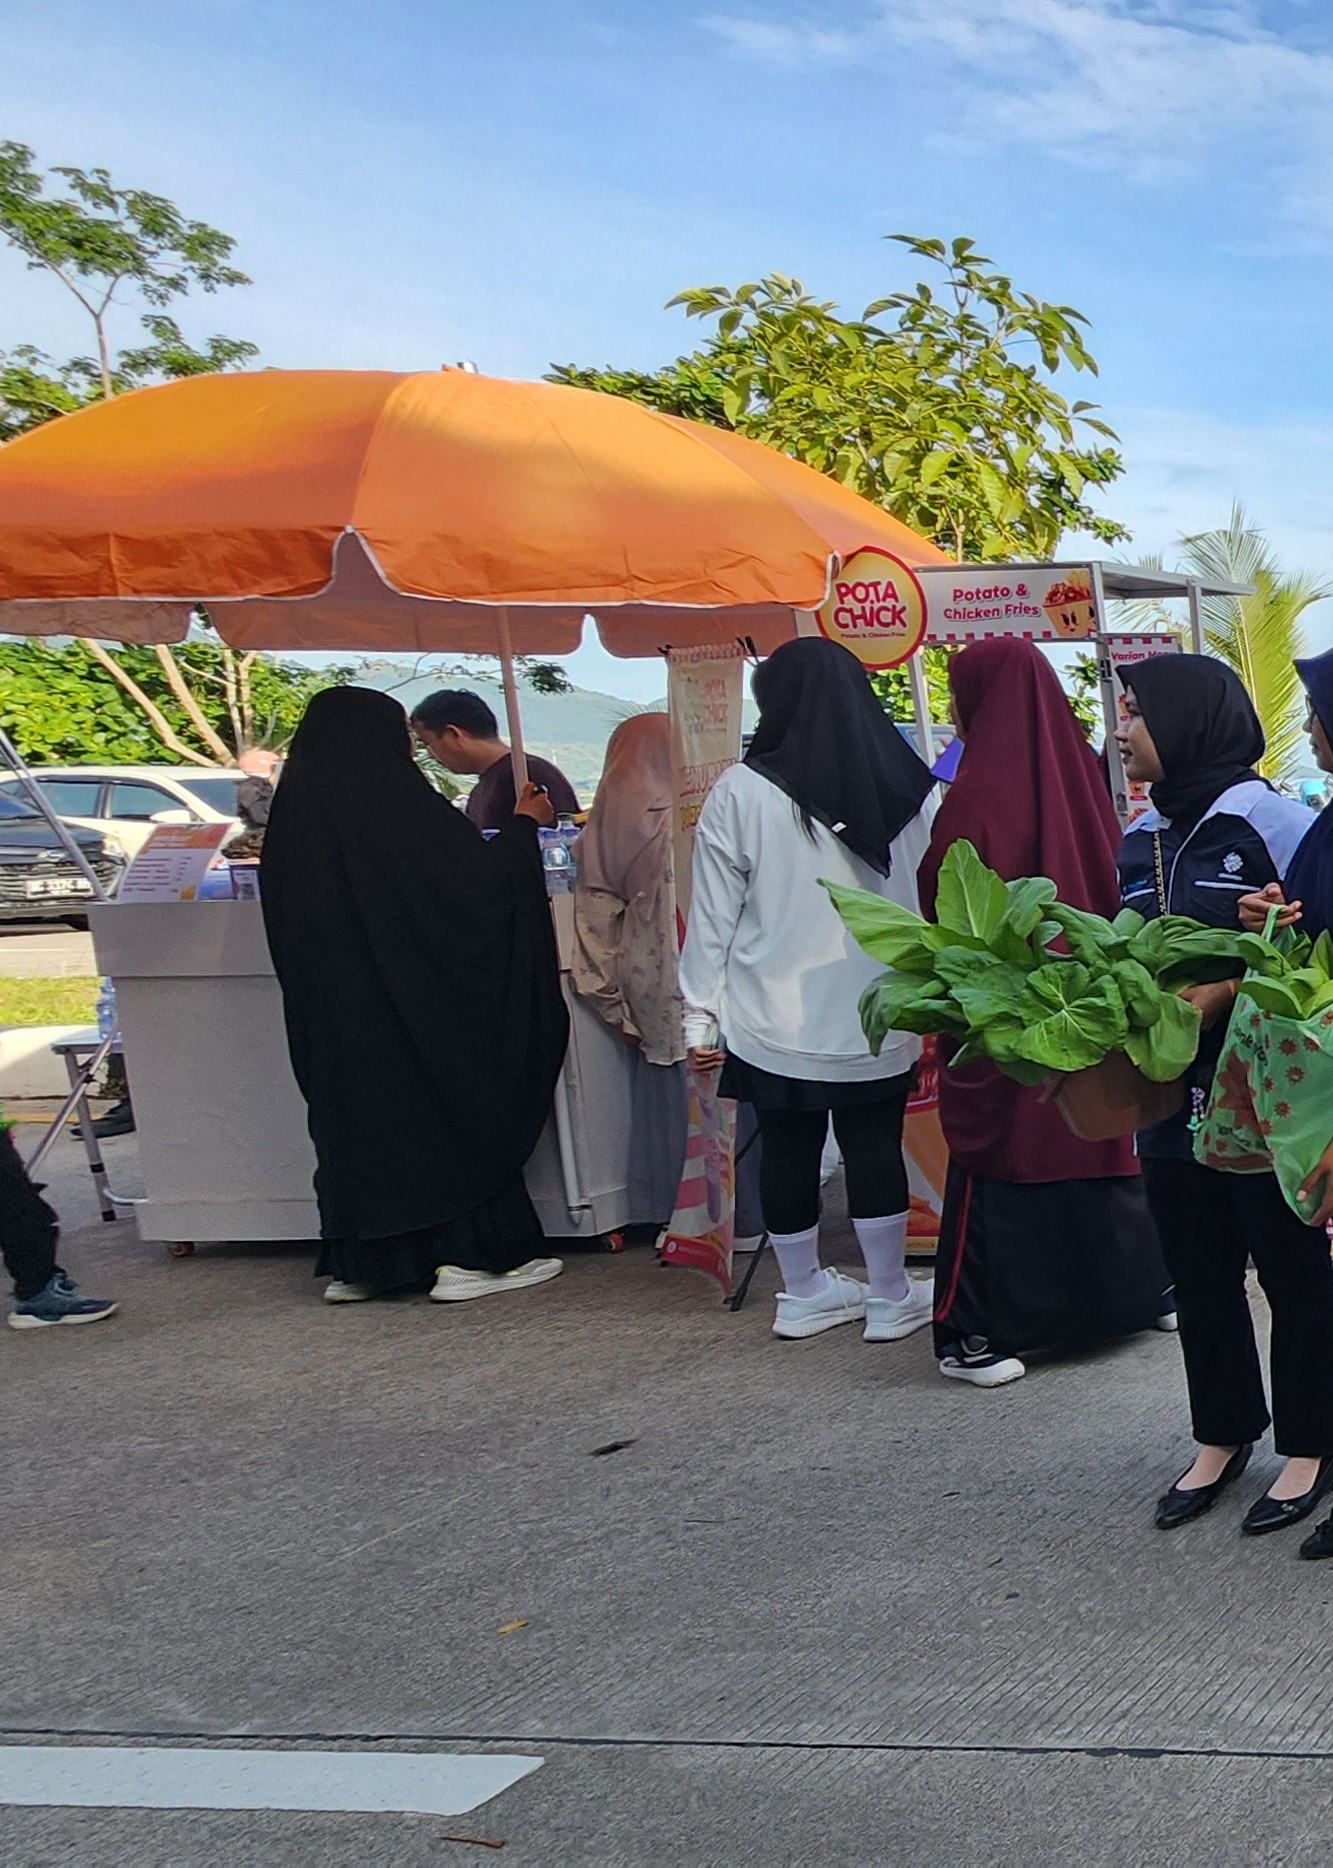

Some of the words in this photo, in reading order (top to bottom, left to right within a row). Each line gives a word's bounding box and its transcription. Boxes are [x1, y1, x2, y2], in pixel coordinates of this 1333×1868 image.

[835, 581, 899, 605] POTA
[953, 585, 1011, 602] Potato
[1015, 583, 1028, 596] &
[943, 606, 1000, 620] Chicken
[1004, 602, 1040, 616] Fries
[1111, 651, 1145, 661] Varian
